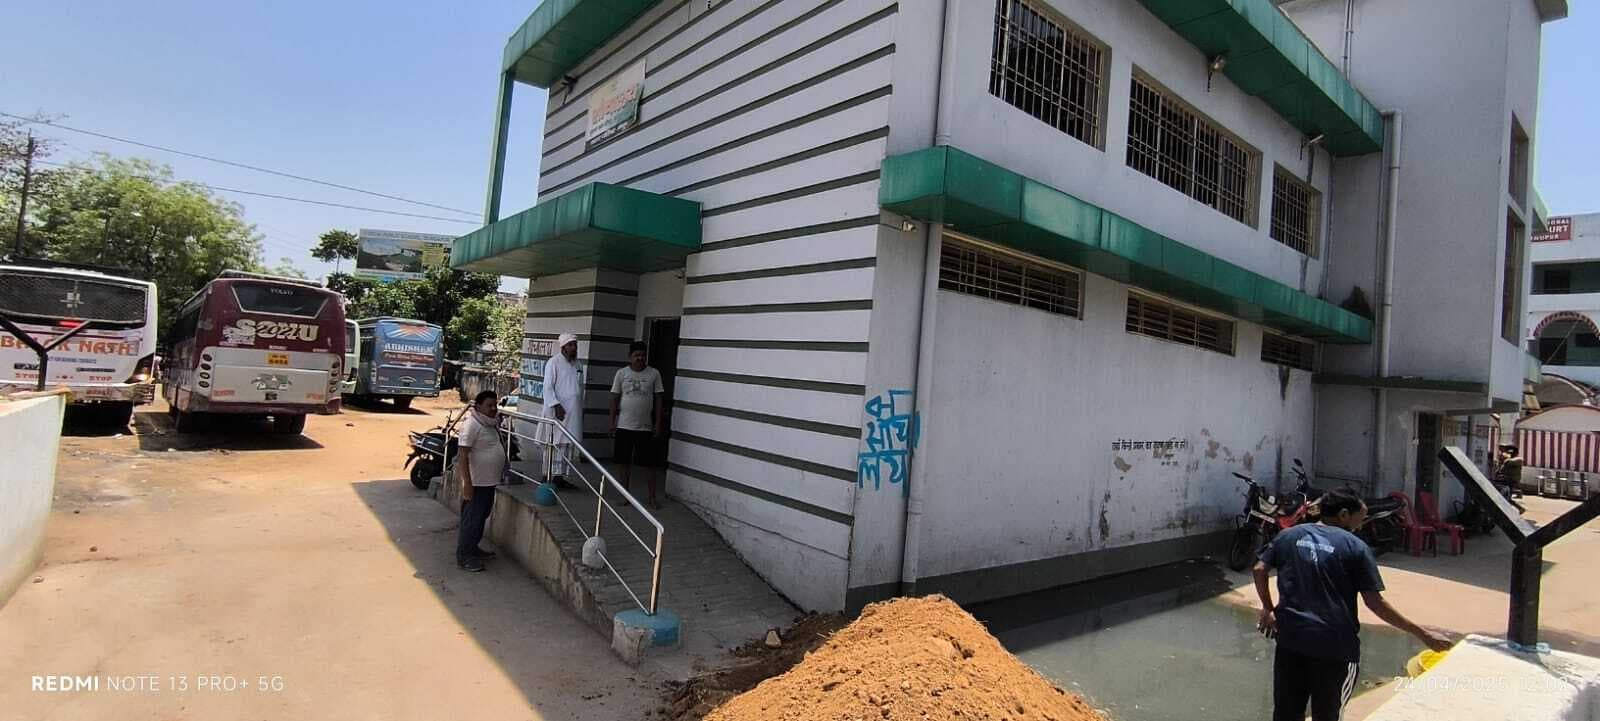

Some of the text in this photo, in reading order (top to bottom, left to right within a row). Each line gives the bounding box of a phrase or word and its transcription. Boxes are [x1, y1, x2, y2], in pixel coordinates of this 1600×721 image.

[1549, 225, 1569, 233] URT
[236, 318, 320, 342] SONU
[78, 340, 130, 356] NATH
